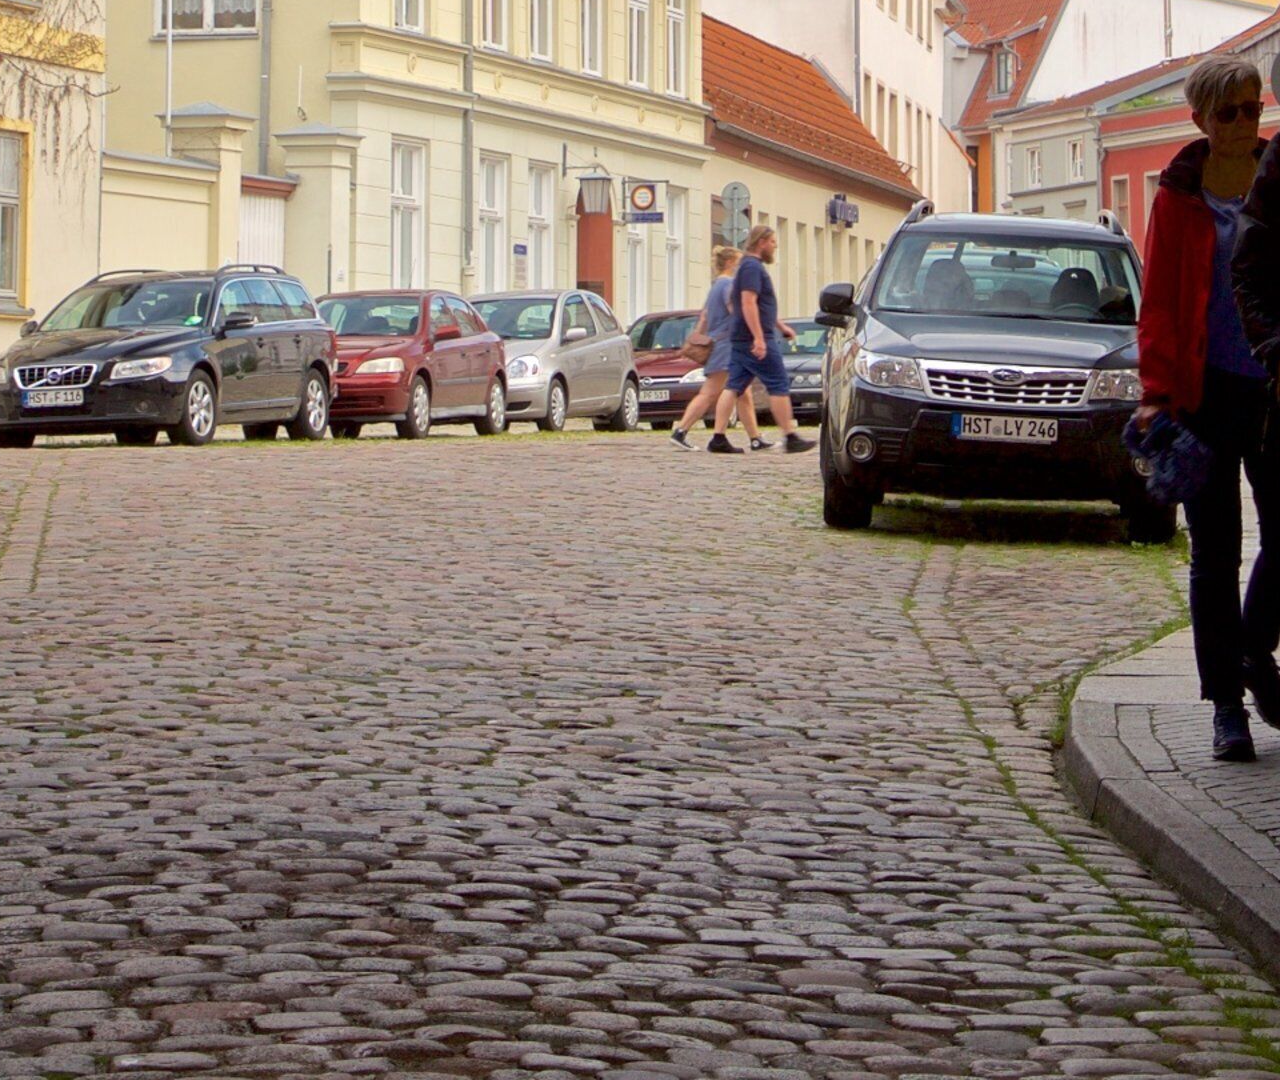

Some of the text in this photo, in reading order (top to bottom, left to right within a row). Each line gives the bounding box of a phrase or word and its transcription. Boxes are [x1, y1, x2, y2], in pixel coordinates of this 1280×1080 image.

[28, 391, 82, 404] HST F 116
[962, 416, 1056, 438] HST LY 246
